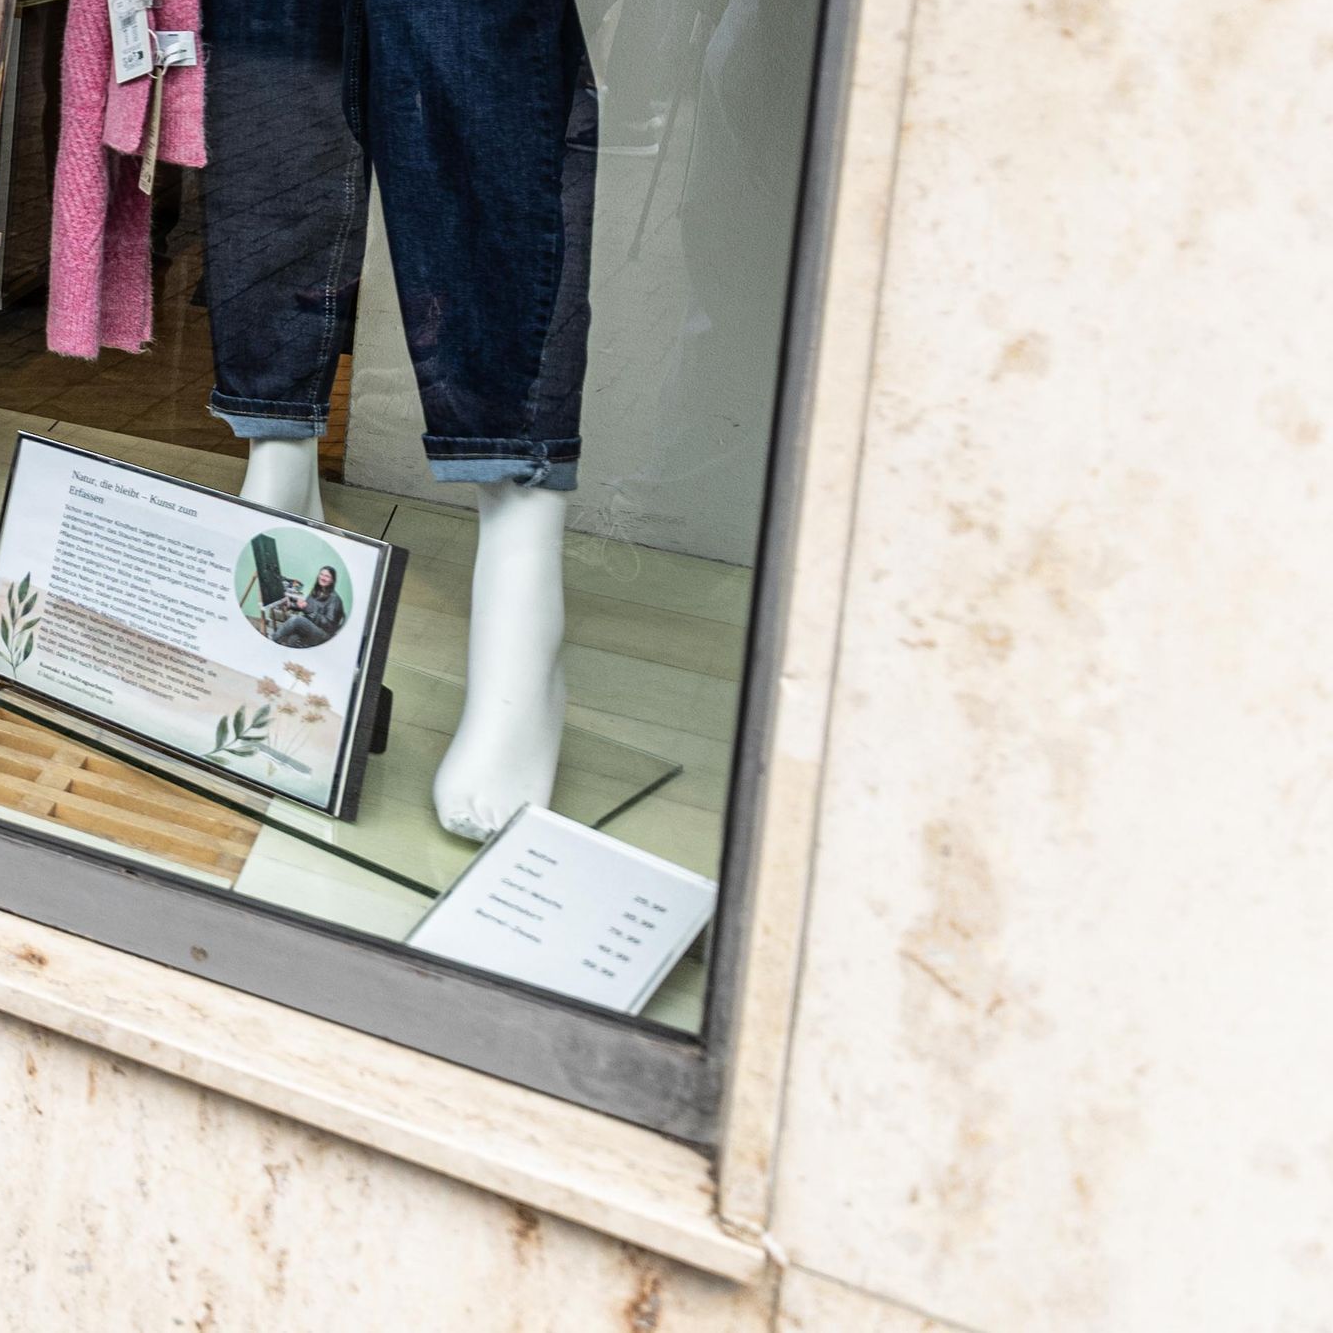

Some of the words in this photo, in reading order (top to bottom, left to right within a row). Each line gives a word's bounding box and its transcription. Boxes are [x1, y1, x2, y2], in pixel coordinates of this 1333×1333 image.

[68, 485, 104, 504] Erfassen
[71, 470, 99, 487] Natur,
[98, 478, 114, 491] die
[113, 483, 140, 499] bleibt
[148, 494, 177, 510] Kunst
[176, 503, 198, 517] zum
